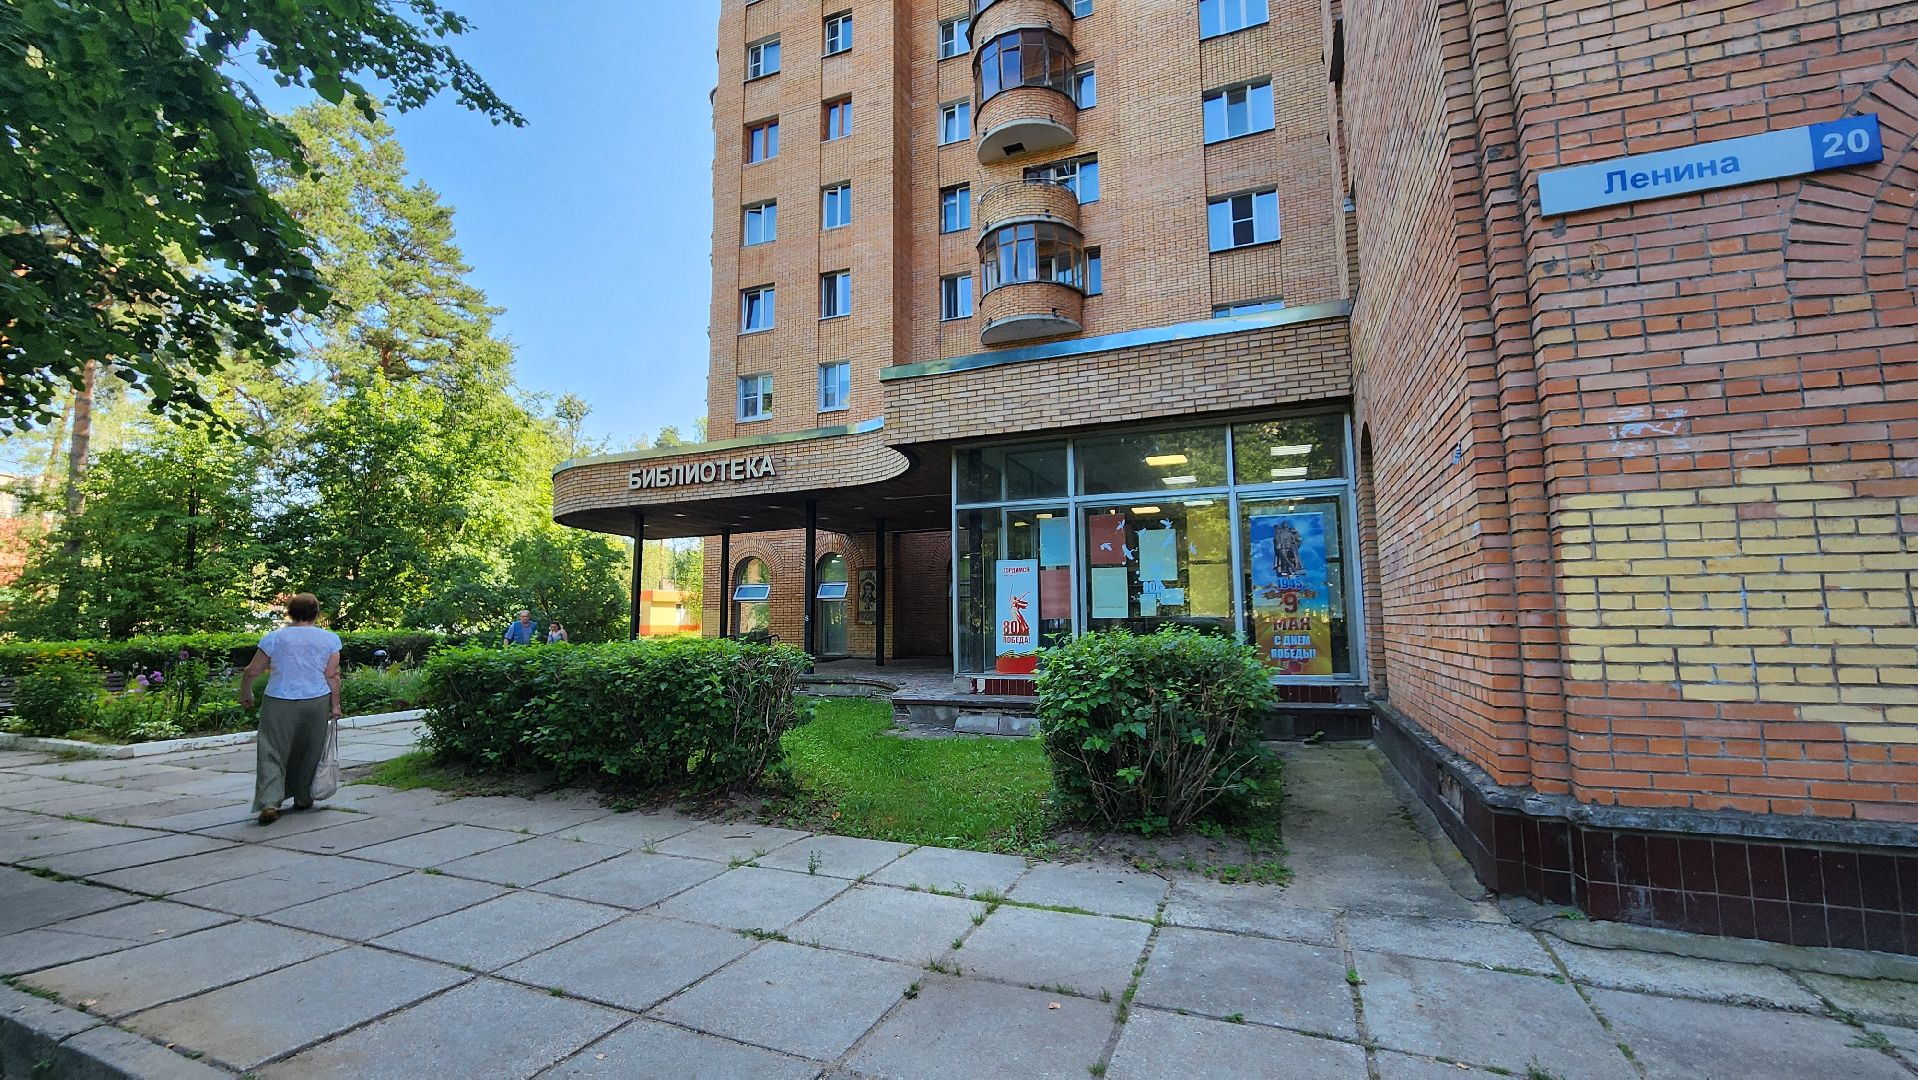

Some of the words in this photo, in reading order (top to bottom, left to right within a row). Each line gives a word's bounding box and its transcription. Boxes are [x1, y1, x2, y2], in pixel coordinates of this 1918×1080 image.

[1604, 155, 1740, 195] Ленина
[1822, 128, 1870, 158] 20
[628, 455, 776, 490] БИБЛИОТЕКА
[1277, 579, 1304, 589] 1945
[1283, 591, 1298, 613] 9
[1003, 620, 1018, 635] 80
[1272, 616, 1312, 631] МАЯ
[1003, 636, 1031, 645] ПОБЕДА!
[1270, 648, 1317, 660] ПОБЕДЫ!
